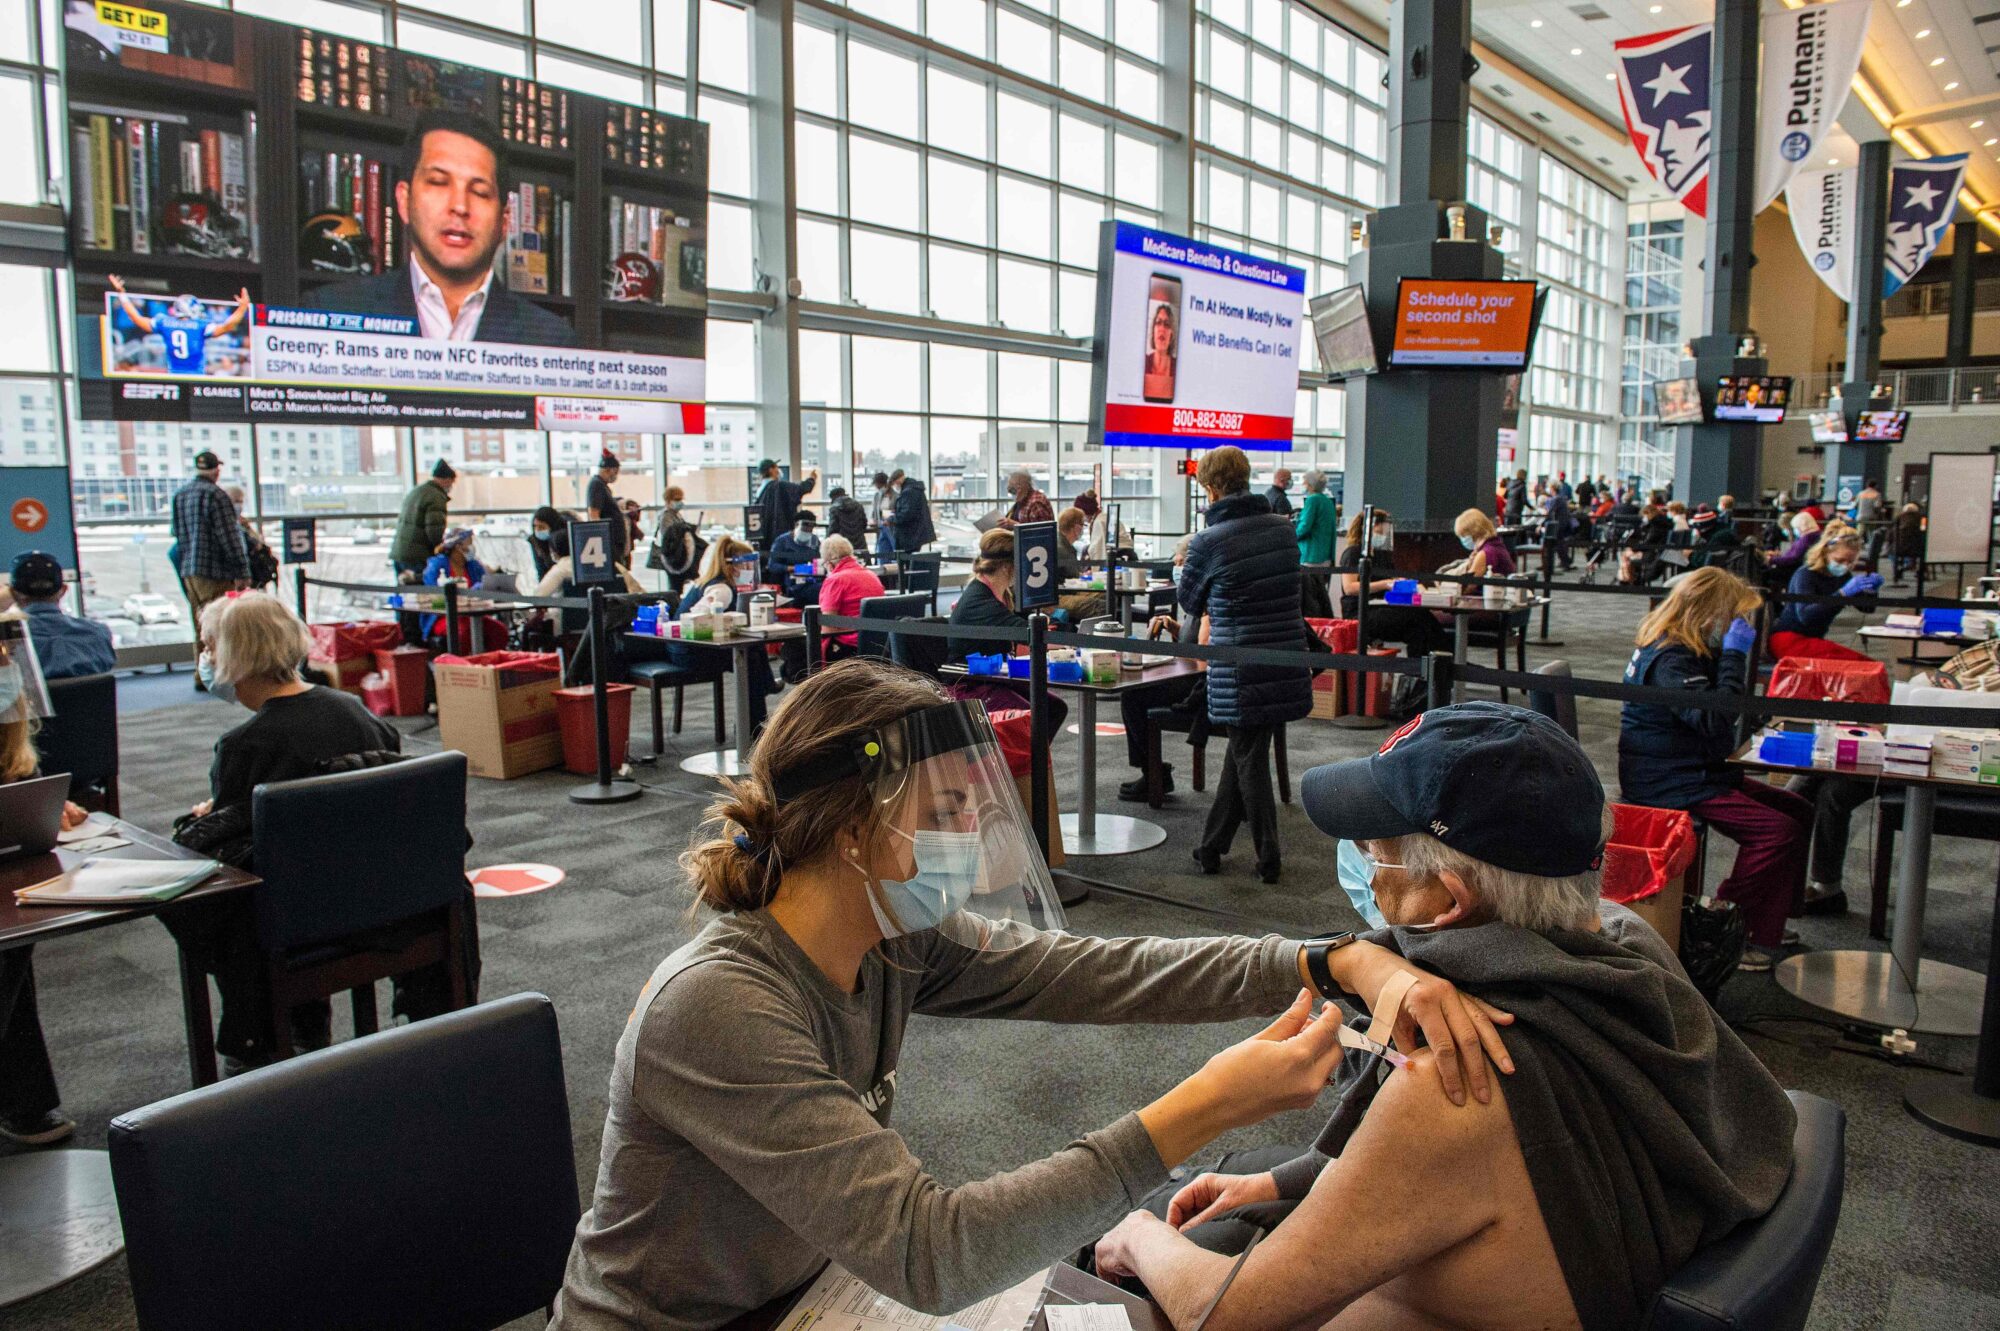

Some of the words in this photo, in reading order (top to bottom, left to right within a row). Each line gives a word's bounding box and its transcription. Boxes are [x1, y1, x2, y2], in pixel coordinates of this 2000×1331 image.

[102, 7, 135, 24] GET
[140, 13, 160, 29] UP
[1787, 11, 1817, 126] Putnam
[1812, 9, 1827, 124] INVESTMENTS
[1818, 173, 1835, 248] Putnam
[1142, 237, 1186, 262] Medicare
[1187, 247, 1222, 271] Benefits
[1223, 255, 1231, 272] &
[1232, 259, 1271, 283] Questions
[1271, 270, 1288, 286] Line
[1189, 295, 1205, 313] I'm
[1206, 301, 1217, 315] At
[1219, 302, 1244, 320] Home
[1246, 307, 1274, 328] Mostly
[1275, 312, 1293, 328] Now
[1408, 291, 1477, 306] Schedule
[1480, 295, 1514, 310] your
[267, 309, 328, 328] PRISONER
[363, 317, 413, 334] MOMENT
[1406, 310, 1461, 323] second
[1464, 311, 1497, 324] shot
[171, 329, 189, 360] 9
[267, 335, 329, 358] Greeny:
[335, 340, 379, 358] Rams
[385, 346, 408, 359] are
[414, 348, 442, 362] now
[448, 346, 476, 364] NFC
[482, 351, 538, 369] favorites
[543, 357, 595, 375] entering
[599, 361, 624, 374] next
[627, 363, 667, 377] season
[1192, 329, 1216, 345] What
[1218, 333, 1254, 353] Benefits
[1255, 340, 1271, 355] Can
[1278, 344, 1292, 358] Get
[267, 359, 305, 375] ESPN's
[308, 361, 338, 376] Adam
[390, 367, 415, 380] Lions
[417, 368, 441, 380] trade
[444, 369, 483, 384] Matthew
[523, 375, 531, 386] to
[535, 375, 557, 387] Rams
[560, 376, 571, 388] for
[572, 377, 593, 390] Jared
[596, 378, 612, 390] Goff
[614, 379, 621, 390] &
[623, 379, 628, 391] 3
[630, 380, 647, 392] draft
[649, 382, 668, 394] picks
[122, 383, 180, 400] ESPN
[193, 386, 202, 397] X
[203, 387, 241, 398] GAMES
[249, 386, 285, 400] Men's
[287, 389, 349, 402] Snowboard
[350, 391, 370, 404] Big
[371, 391, 387, 403] Air
[251, 400, 282, 412] GOLD:
[285, 402, 321, 414] Marcus
[453, 408, 481, 418] Games
[482, 408, 500, 420] gold
[1173, 409, 1244, 430] 800-882-0987
[748, 513, 761, 532] 5
[290, 529, 310, 554] 5
[580, 536, 607, 568] 4
[1026, 546, 1049, 588] 3
